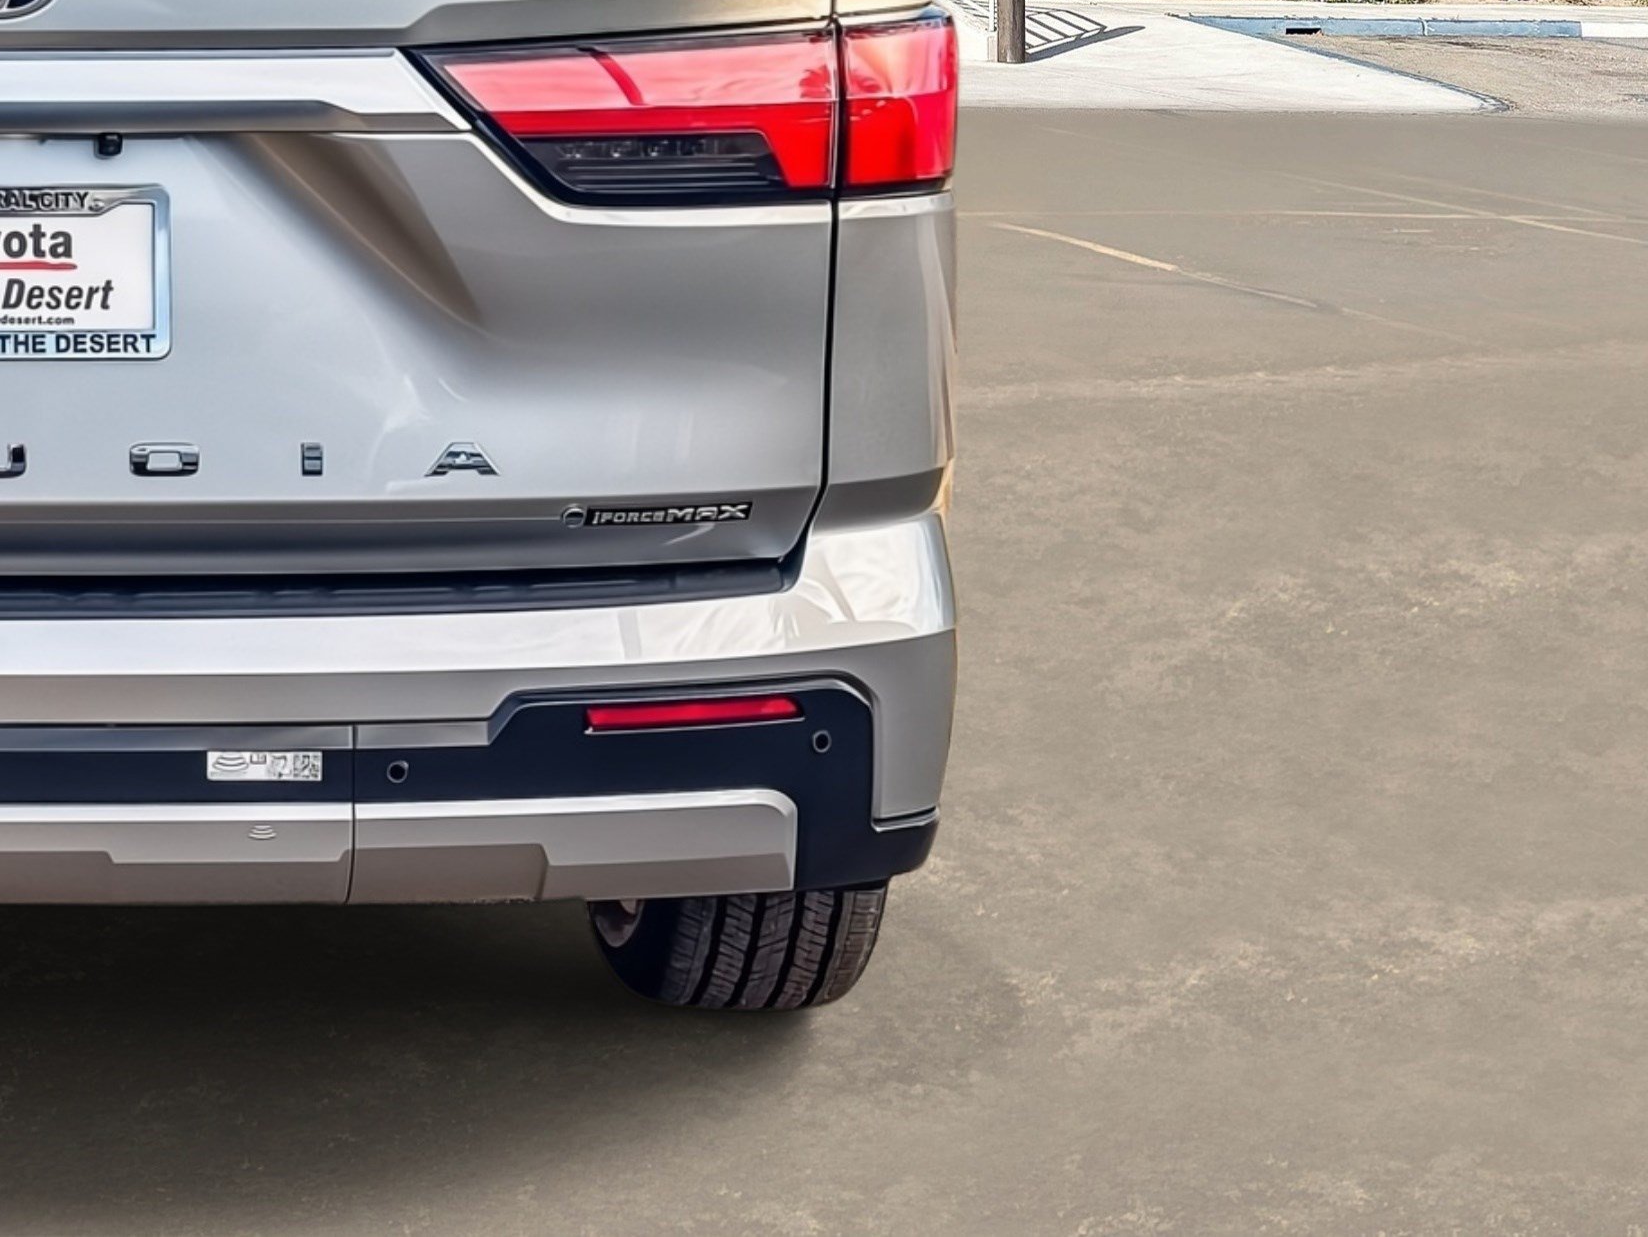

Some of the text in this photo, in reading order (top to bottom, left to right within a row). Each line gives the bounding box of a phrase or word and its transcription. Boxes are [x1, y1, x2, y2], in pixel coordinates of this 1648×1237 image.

[38, 191, 90, 209] CITY
[2, 278, 113, 310] Desert
[55, 333, 156, 354] DESERT
